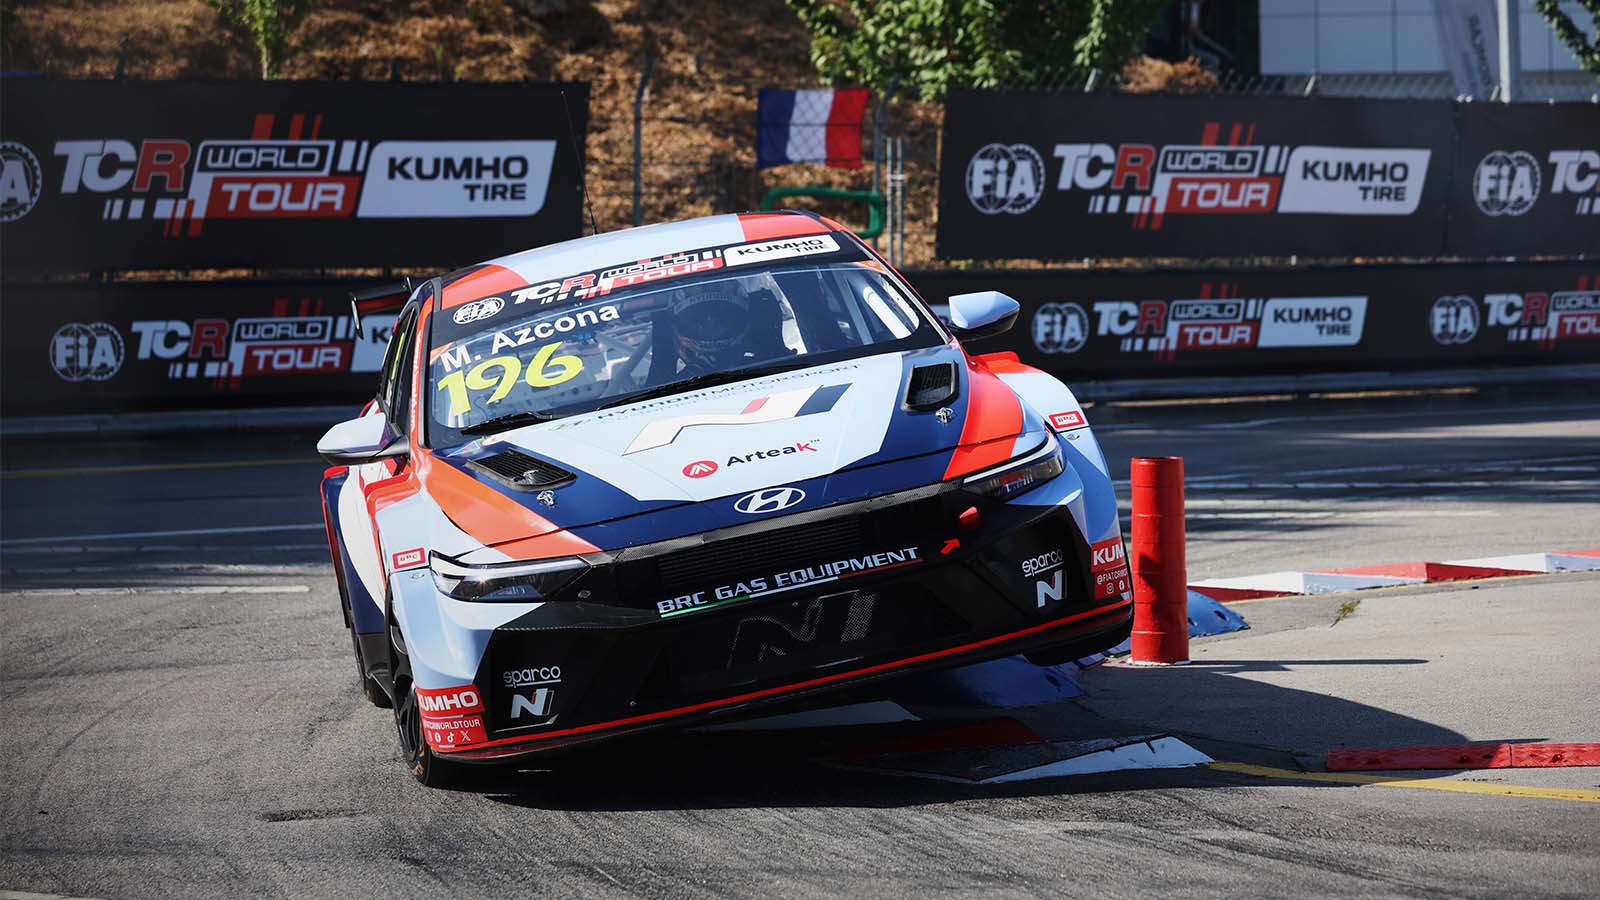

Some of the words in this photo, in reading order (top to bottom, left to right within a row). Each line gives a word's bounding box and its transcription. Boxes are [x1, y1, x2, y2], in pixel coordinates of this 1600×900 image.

[54, 139, 191, 193] TCR
[206, 147, 321, 169] WORLD
[388, 155, 529, 181] KUMHO
[1053, 143, 1157, 190] TCR
[1166, 152, 1251, 170] WORLD
[1302, 159, 1409, 183] KUMHO
[1548, 149, 1600, 193] TC
[221, 182, 346, 212] TOUR
[463, 183, 527, 202] TIRE
[1176, 182, 1271, 208] TOUR
[1358, 185, 1407, 202] TIRE
[737, 237, 825, 255] KUMHO
[790, 244, 826, 254] TIRE
[607, 254, 693, 278] WORLD
[620, 260, 717, 284] TOUR
[510, 273, 597, 304] TCR
[1092, 300, 1167, 336] TCR
[1174, 304, 1237, 319] WORLD
[1273, 306, 1352, 324] KUMHO
[1483, 292, 1549, 326] TCR
[130, 318, 230, 360] TCR
[240, 322, 323, 339] WORLD
[440, 344, 482, 373] M.
[491, 304, 621, 354] Azcona
[1183, 325, 1252, 346] TOUR
[1315, 323, 1352, 336] TIRE
[251, 347, 342, 370] TOUR
[436, 341, 584, 417] 196
[1021, 549, 1063, 577] sparco
[656, 590, 709, 614] BRC
[714, 577, 768, 600] GAS
[773, 546, 919, 588] EQUIPMENT
[503, 665, 561, 688] sparco
